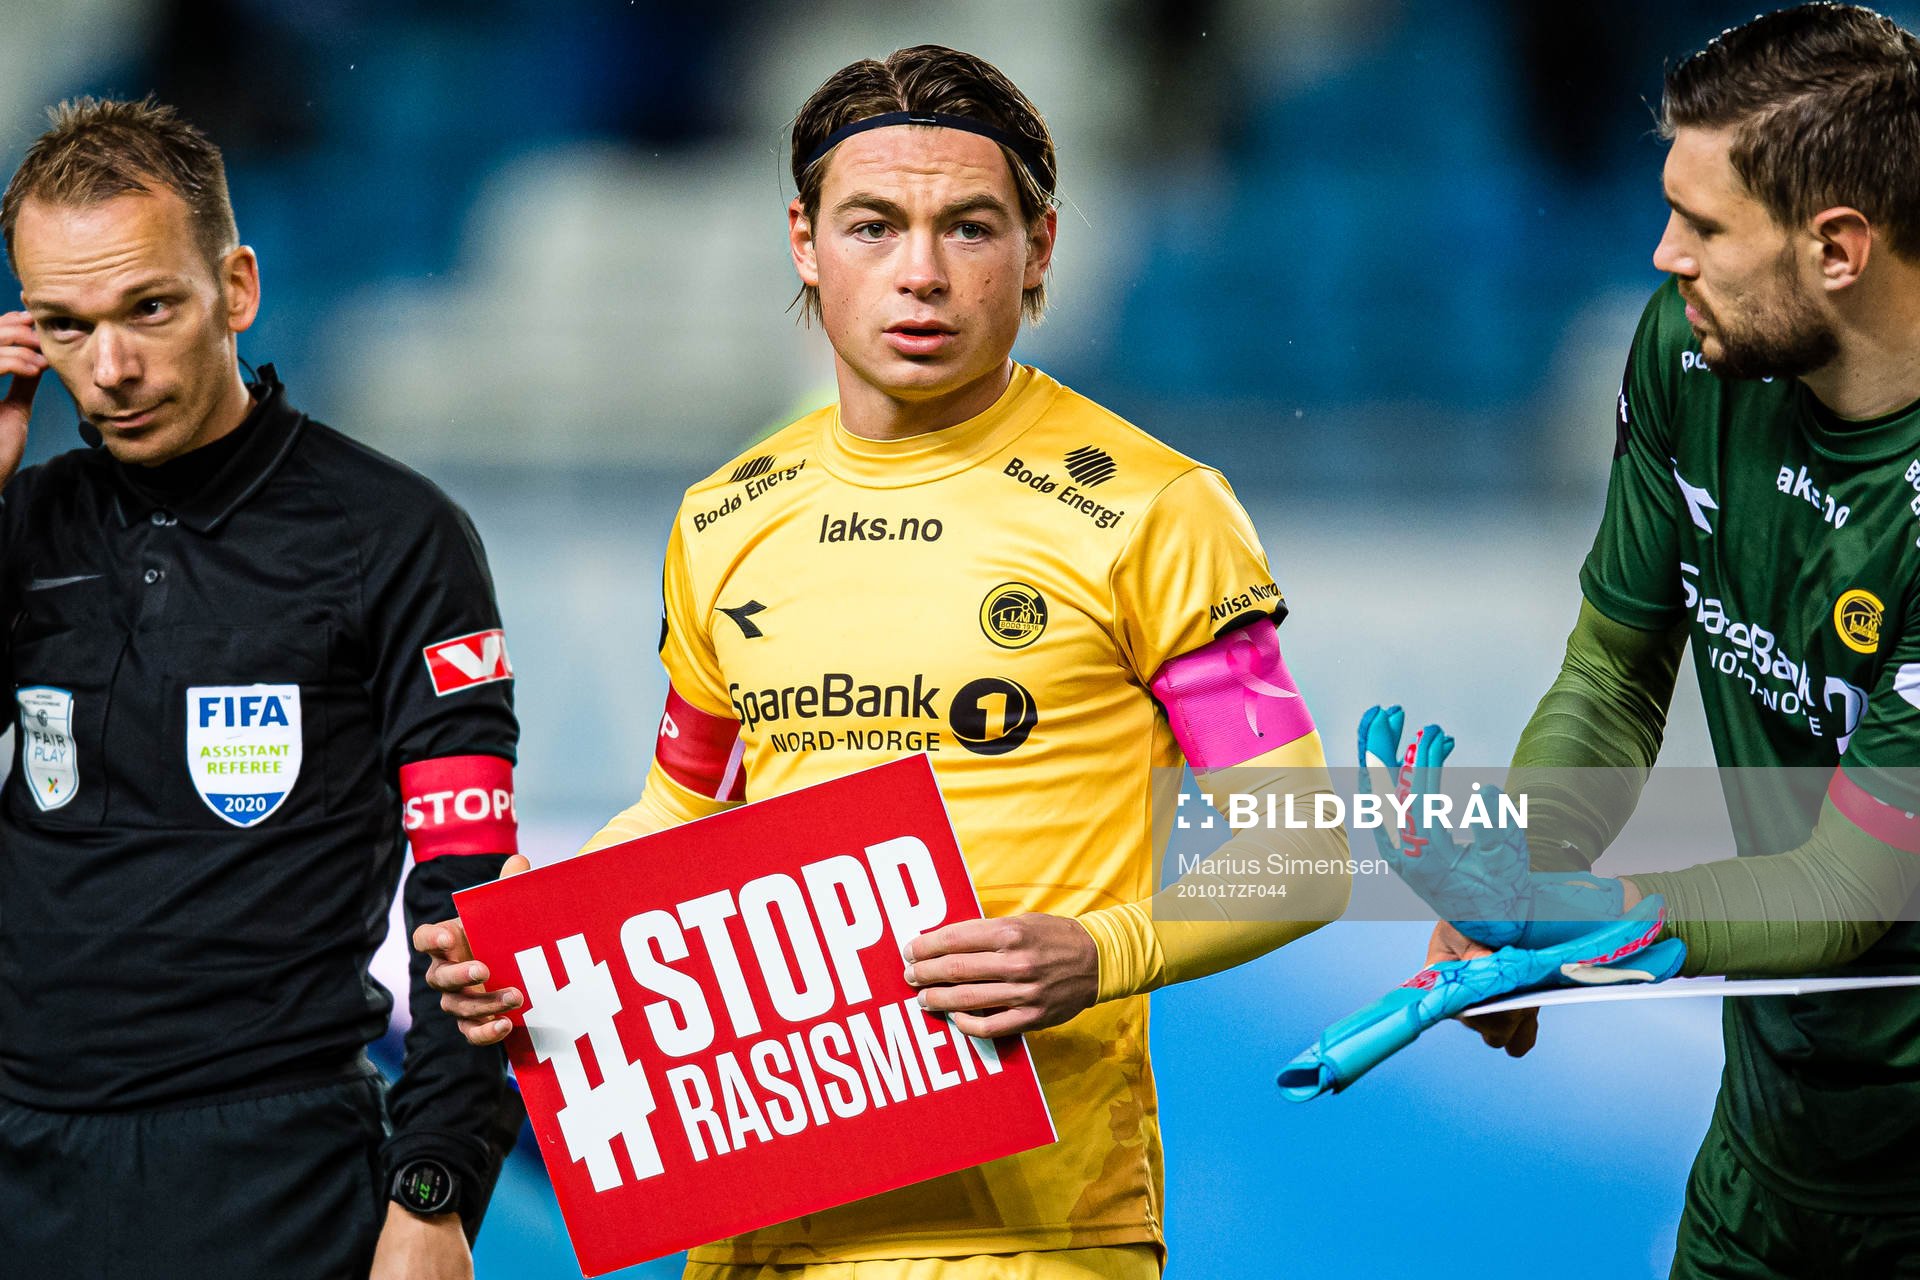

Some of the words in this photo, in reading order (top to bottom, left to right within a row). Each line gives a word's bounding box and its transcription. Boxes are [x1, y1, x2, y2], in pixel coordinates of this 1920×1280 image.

[694, 494, 742, 533] Bodø
[745, 458, 807, 502] Energi
[1003, 457, 1059, 493] Bodø
[1057, 485, 1125, 529] Energi
[819, 512, 943, 543] laks.no
[1209, 593, 1252, 625] Avisa
[199, 695, 289, 728] FIFA
[729, 673, 940, 733] SpareBank
[33, 731, 66, 747] FAIR
[34, 746, 66, 763] PLAY
[200, 744, 290, 758] ASSISTANT
[771, 730, 940, 752] NORD-NORGE
[207, 761, 283, 775] REFEREE
[224, 797, 267, 812] 2020
[403, 788, 517, 831] STOP
[667, 996, 1004, 1162] RASISMEN
